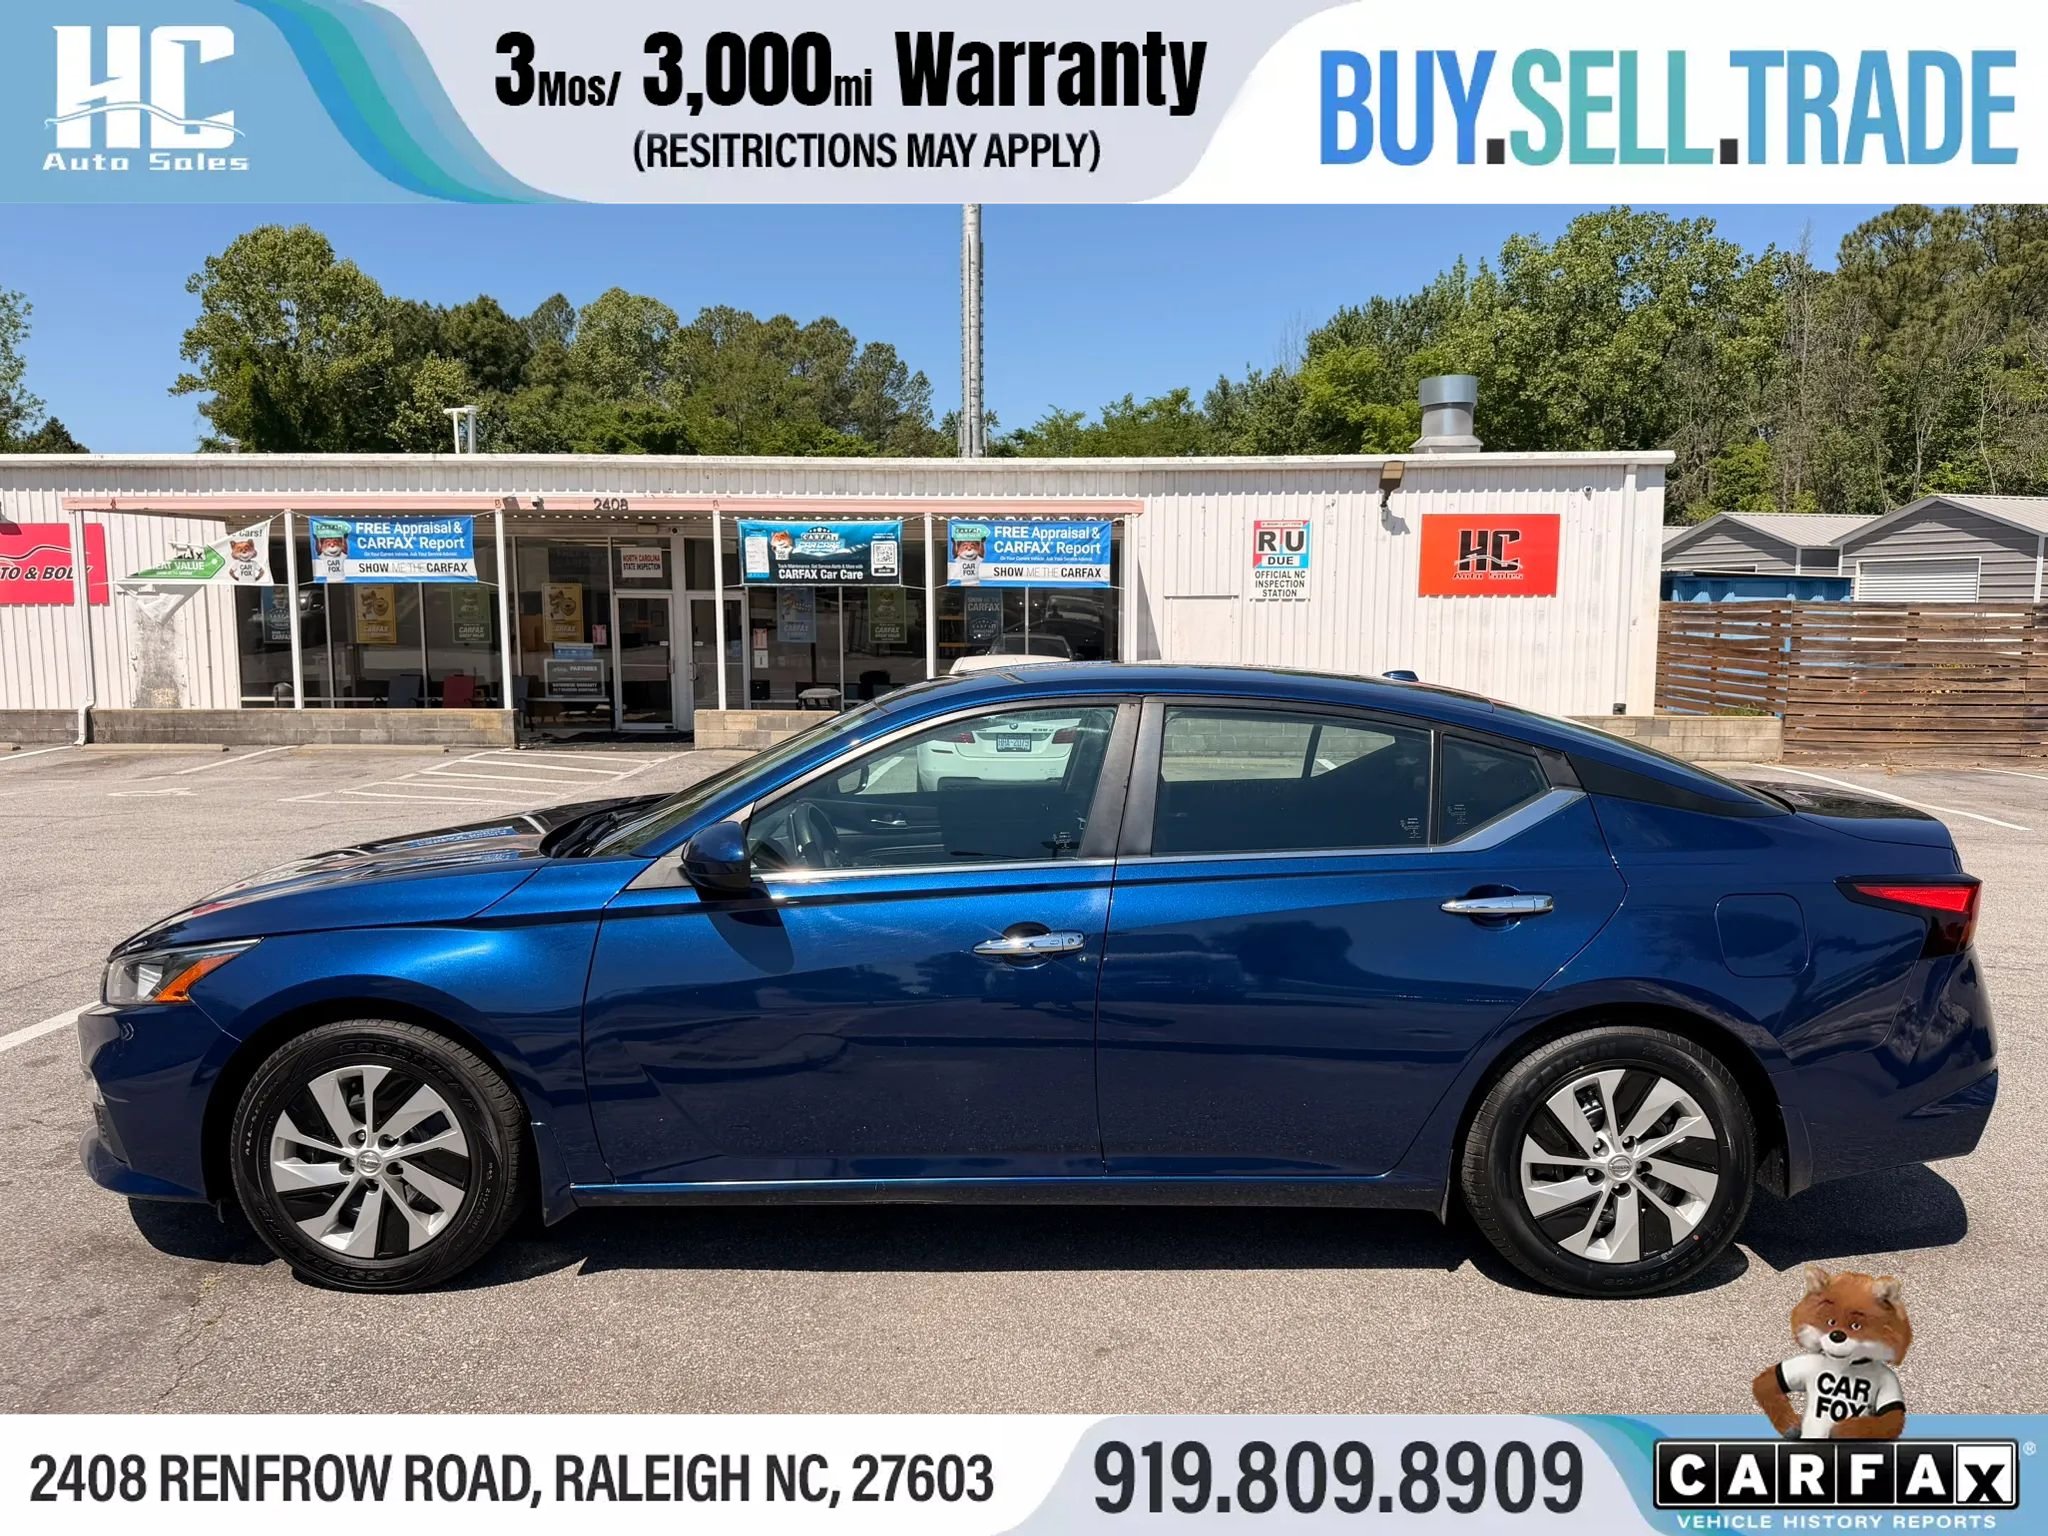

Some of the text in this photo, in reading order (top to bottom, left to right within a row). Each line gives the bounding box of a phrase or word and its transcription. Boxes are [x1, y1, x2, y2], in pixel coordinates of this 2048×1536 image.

[593, 498, 629, 510] 2408
[355, 520, 463, 539] FREE Appraisal &
[994, 526, 1100, 543] FREE Appraisal &
[357, 536, 465, 552] CARFAX Report
[993, 541, 1102, 557] CARFAX Report
[1459, 530, 1520, 571] HC
[174, 561, 205, 570] VALUE
[1267, 556, 1294, 565] DUE
[24, 567, 38, 579] &
[359, 563, 468, 573] SHOW ME THE CARFAX
[993, 567, 1102, 577] SHOW ME THE CARFAX
[778, 569, 864, 580] CARFAX Car Care
[1254, 570, 1306, 579] OFFICIAL NC
[1255, 580, 1305, 588] INSPECTION
[1262, 589, 1297, 597] STATION
[967, 603, 1000, 611] CARFAX
